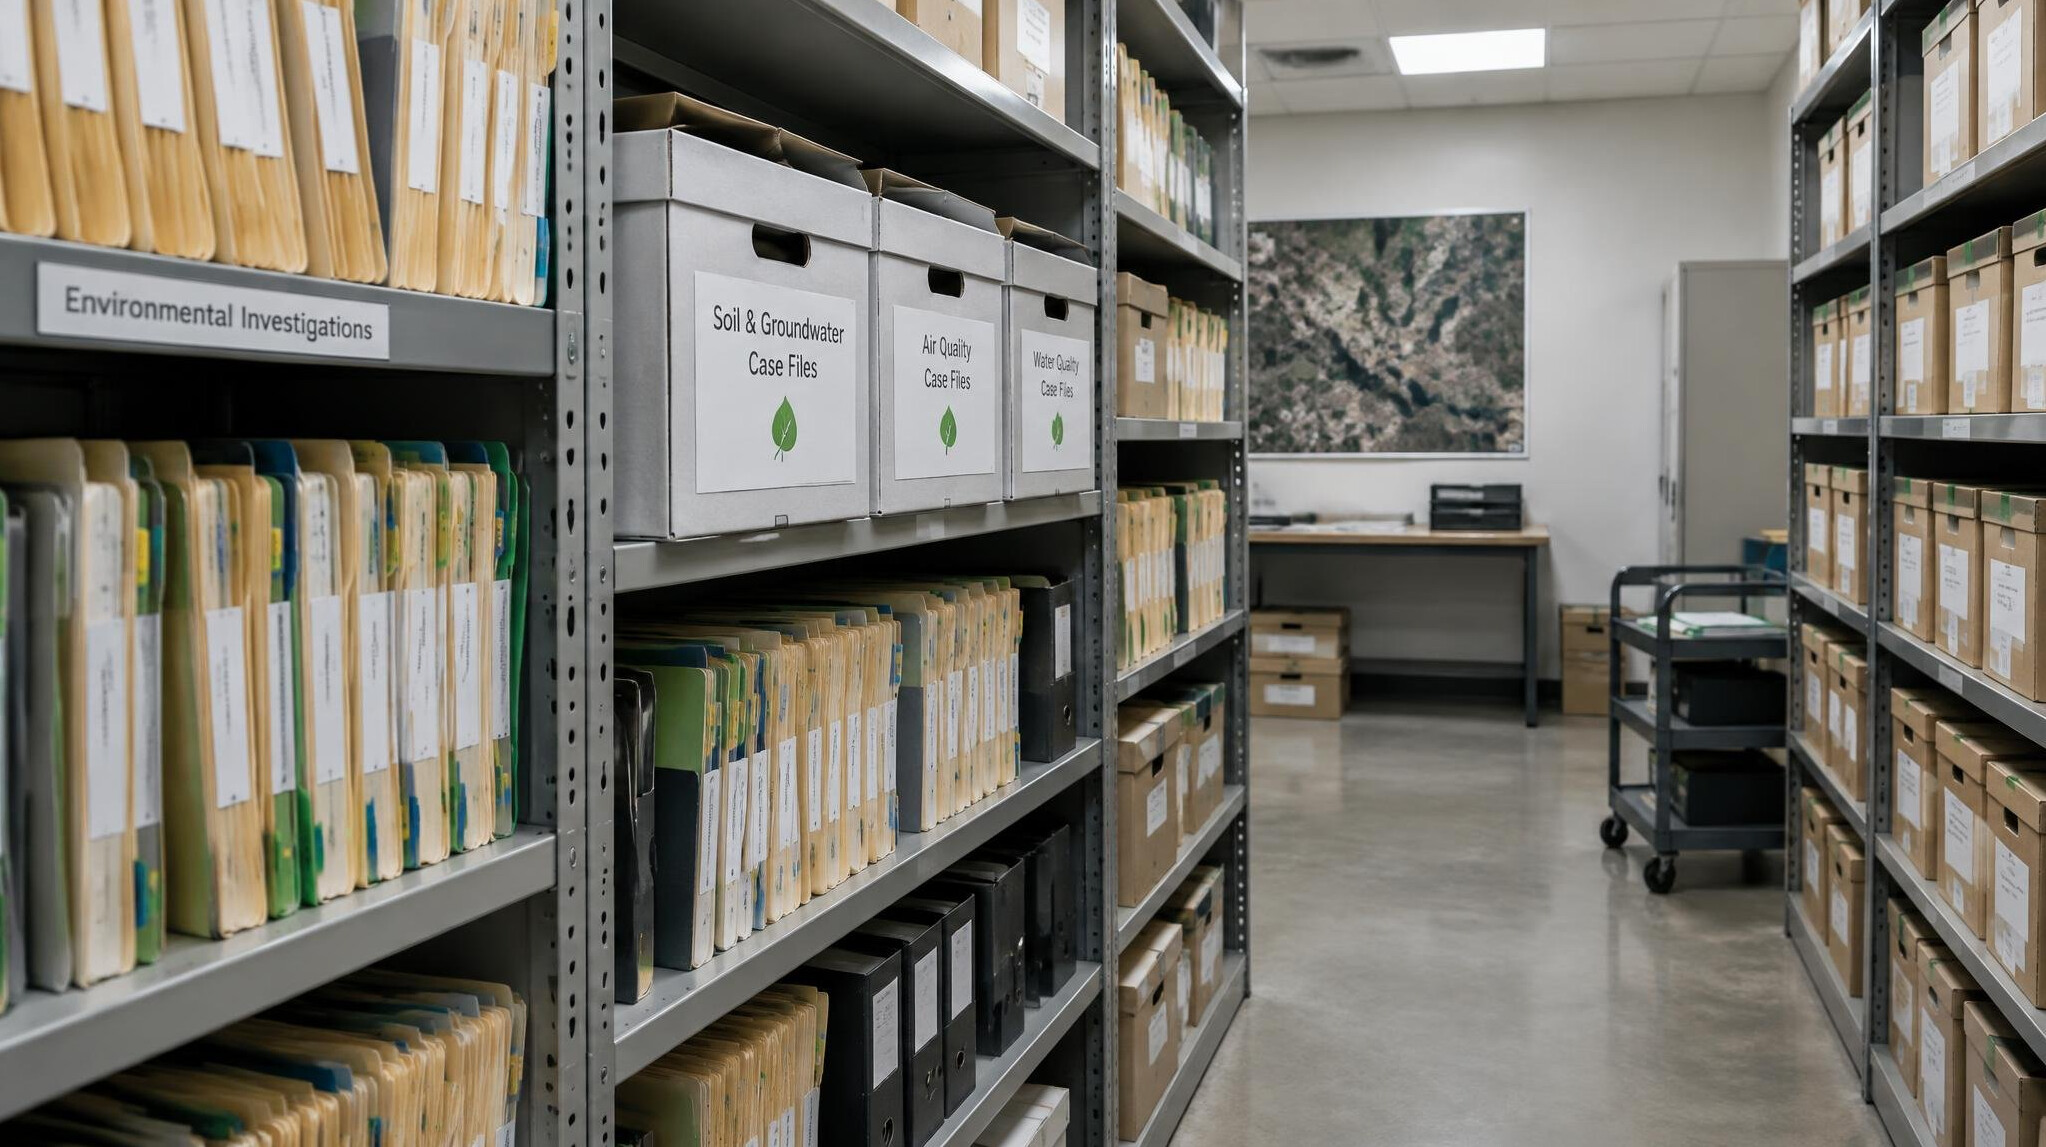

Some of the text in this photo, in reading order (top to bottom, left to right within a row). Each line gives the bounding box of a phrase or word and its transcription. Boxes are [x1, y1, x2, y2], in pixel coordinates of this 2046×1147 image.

[65, 285, 373, 342] Environmental Investigations
[713, 304, 844, 344] Soil & Groundwater
[922, 334, 972, 363] Air Quality
[1033, 350, 1055, 370] Water
[748, 350, 818, 379] Case Files
[924, 367, 971, 391] Case Files
[1041, 379, 1058, 397] Case
